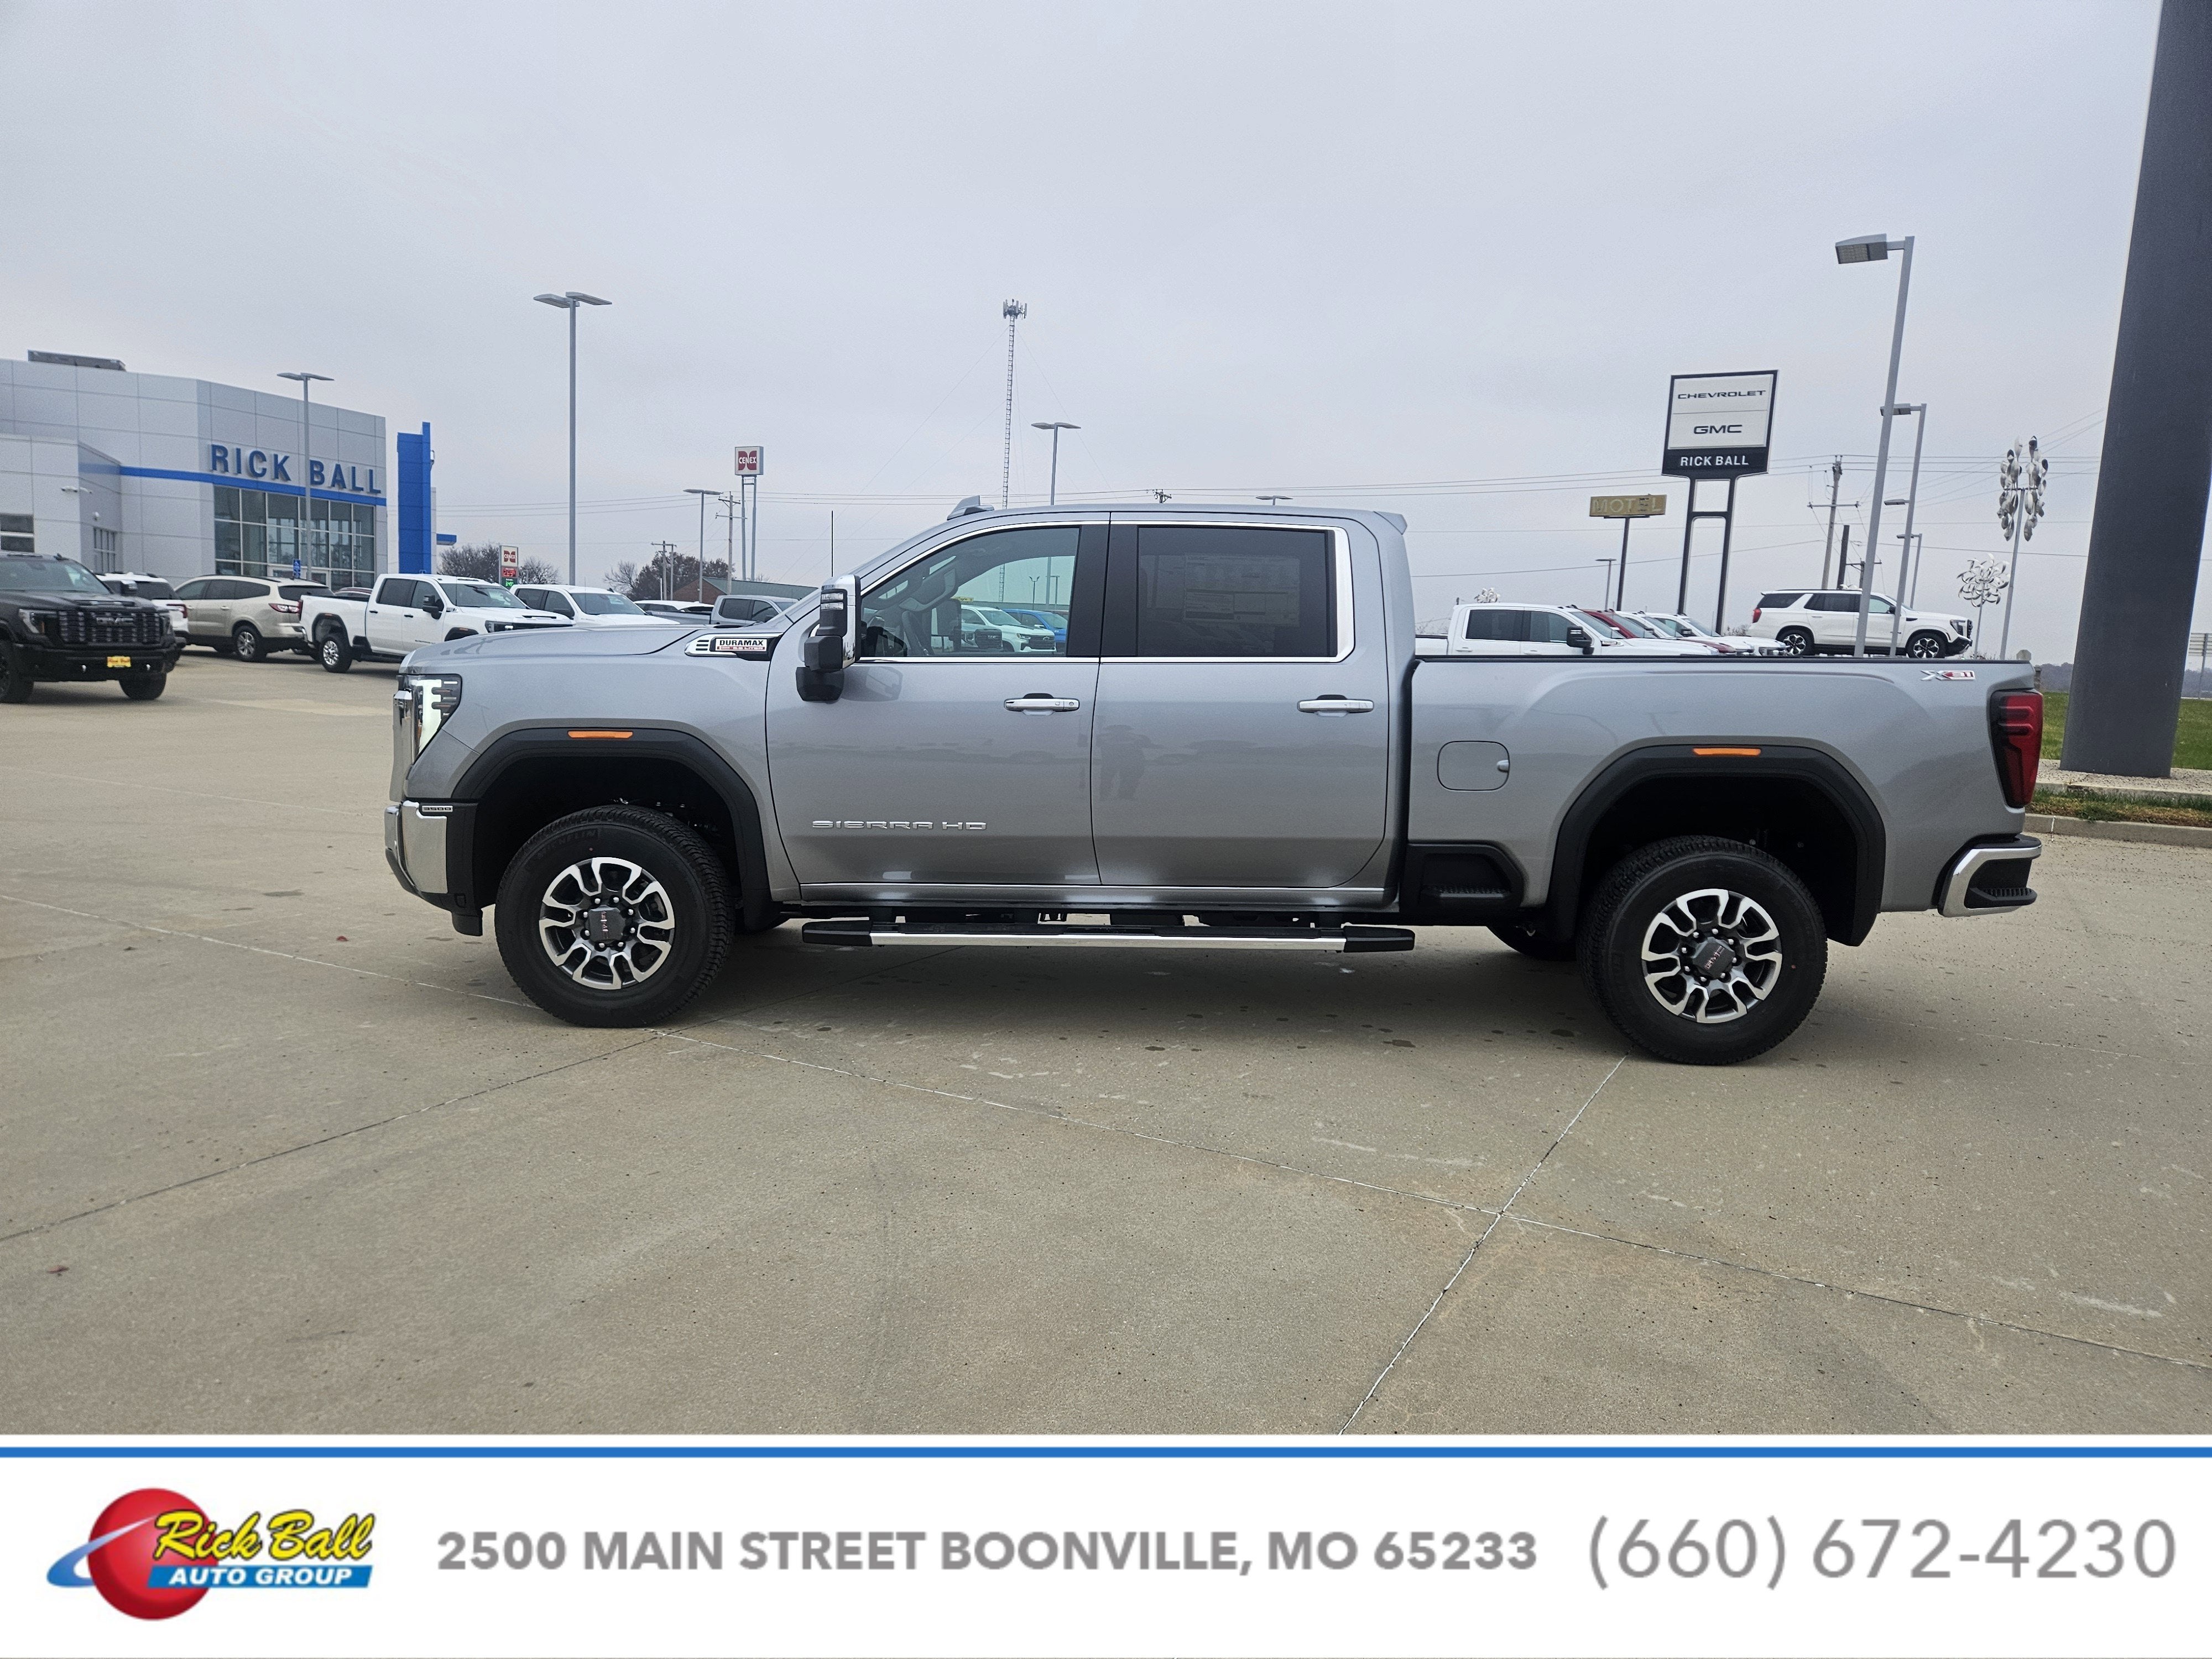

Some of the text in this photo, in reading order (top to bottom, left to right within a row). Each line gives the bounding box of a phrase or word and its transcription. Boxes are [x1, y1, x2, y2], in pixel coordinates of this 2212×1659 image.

[1678, 390, 1766, 399] CHEVROLET
[1694, 425, 1743, 434] GMC
[1680, 455, 1749, 466] RICK BALL
[211, 444, 381, 494] RICK BALL
[1592, 498, 1661, 513] MOTEL
[812, 821, 987, 830] SIERRA HD
